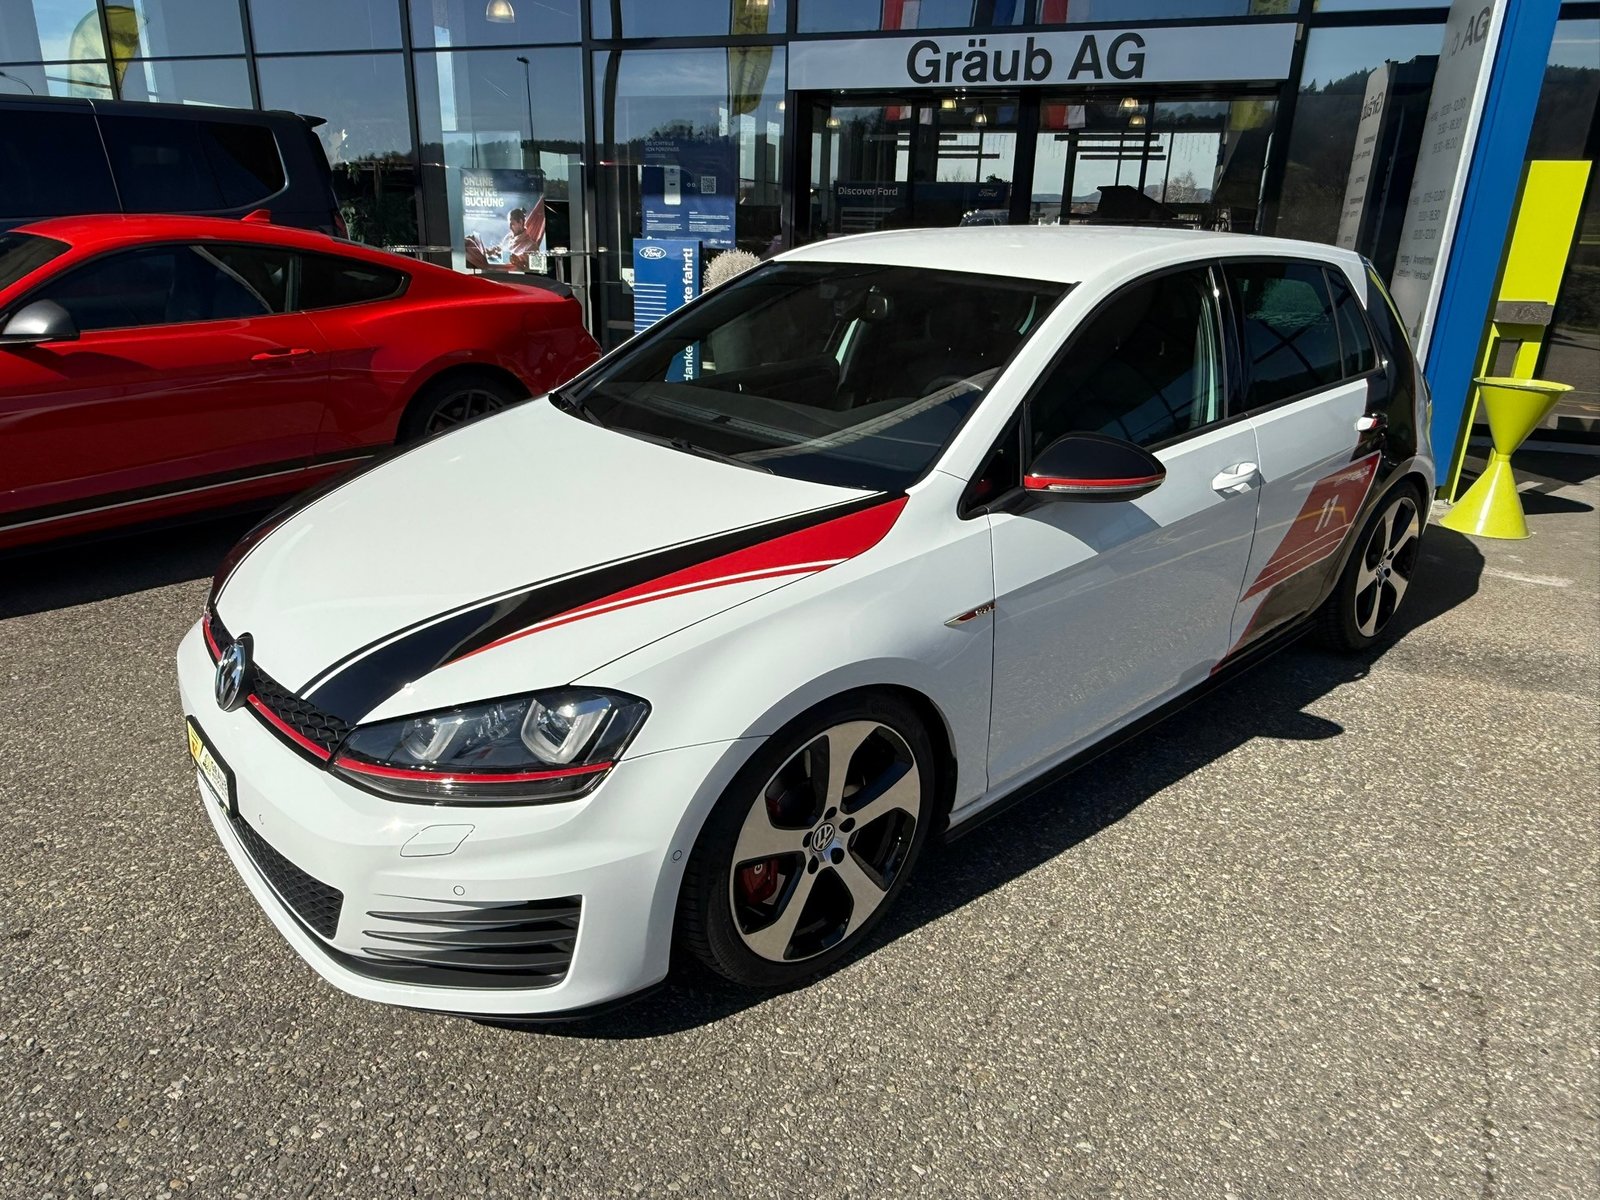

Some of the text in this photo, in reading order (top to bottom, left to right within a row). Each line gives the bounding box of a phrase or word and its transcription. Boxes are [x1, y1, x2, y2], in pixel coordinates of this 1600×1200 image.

[1461, 6, 1491, 50] AG
[907, 32, 1146, 84] Gräub AG
[463, 177, 494, 187] ONLINE
[464, 186, 498, 197] SERVICE
[838, 186, 899, 196] Discover Ford
[465, 197, 505, 208] BUCHUNG
[683, 248, 693, 285] fahrt!
